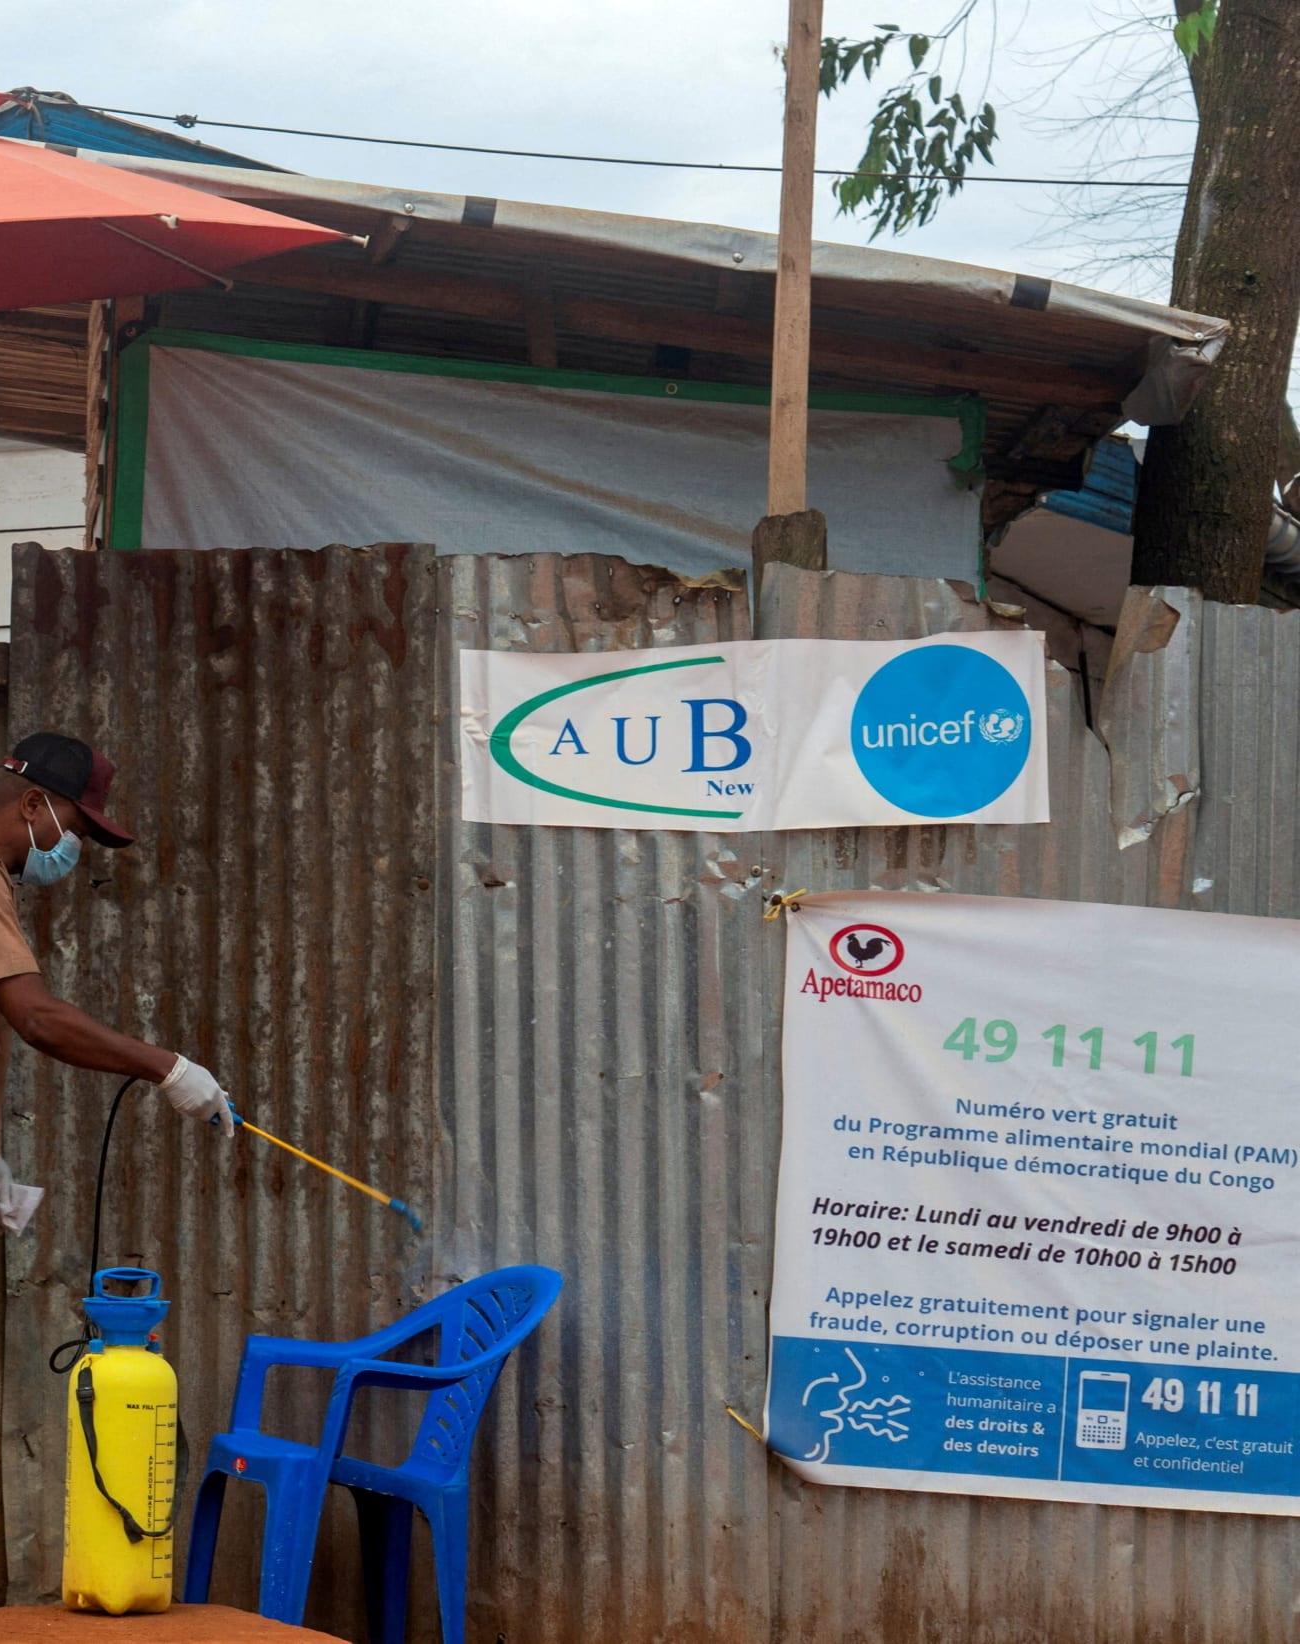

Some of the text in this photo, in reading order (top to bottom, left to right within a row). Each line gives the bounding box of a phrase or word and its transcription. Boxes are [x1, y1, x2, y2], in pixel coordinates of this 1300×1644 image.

[861, 710, 975, 748] unicef
[706, 779, 755, 797] New
[801, 969, 922, 1004] Apetamaco
[943, 1017, 1195, 1077] 49 11 11
[955, 1097, 1178, 1135] Numéro vert gratuit
[833, 1115, 1298, 1169] du Programme alimentaire mondial (PAM)
[848, 1145, 1275, 1194] en République démocratique du Congo
[812, 1197, 1242, 1246] Horaire: Lundi au vendredi de 9h00 à
[811, 1227, 1236, 1275] 19h00 et le samedi de 10h00 à 15h00
[826, 1287, 1266, 1334] Appelez gratuitement pour signaler une
[809, 1312, 1278, 1364] fraude, corruption ou déposer une plainte.
[948, 1372, 1042, 1391] L'assistance
[1141, 1378, 1259, 1417] 49 11 11
[946, 1391, 1056, 1414] humanitaire a
[945, 1415, 1046, 1435] des droits &
[1135, 1431, 1293, 1456] Appelez, c'est gratuit
[943, 1438, 1039, 1458] des devoirs
[1133, 1452, 1244, 1474] et confidentiel
